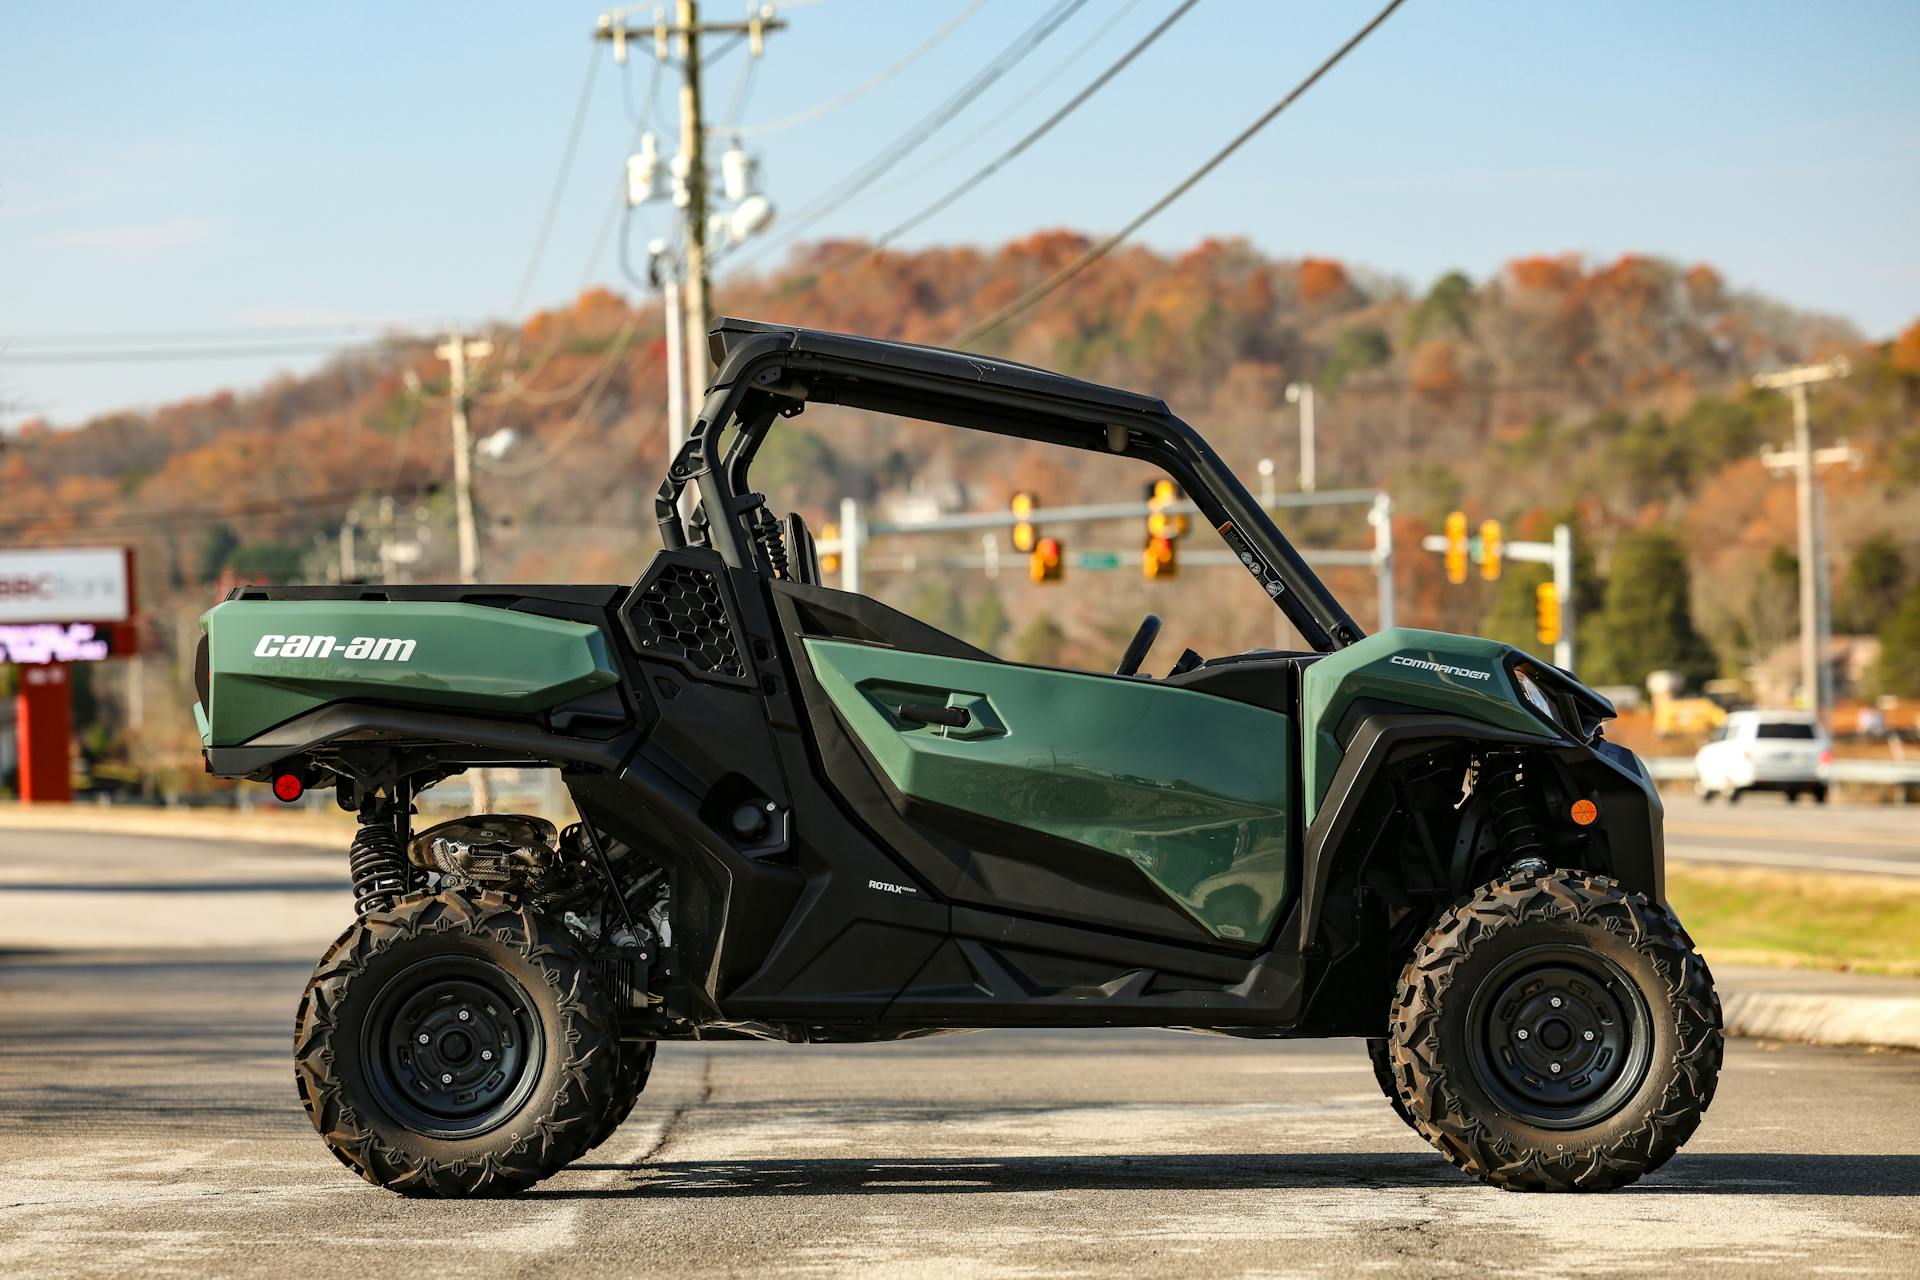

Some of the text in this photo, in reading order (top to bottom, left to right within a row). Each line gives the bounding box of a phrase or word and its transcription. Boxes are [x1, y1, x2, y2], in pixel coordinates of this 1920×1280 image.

[254, 634, 416, 662] can-am
[1391, 656, 1491, 680] COMMANDER
[868, 880, 902, 894] ROTAX
